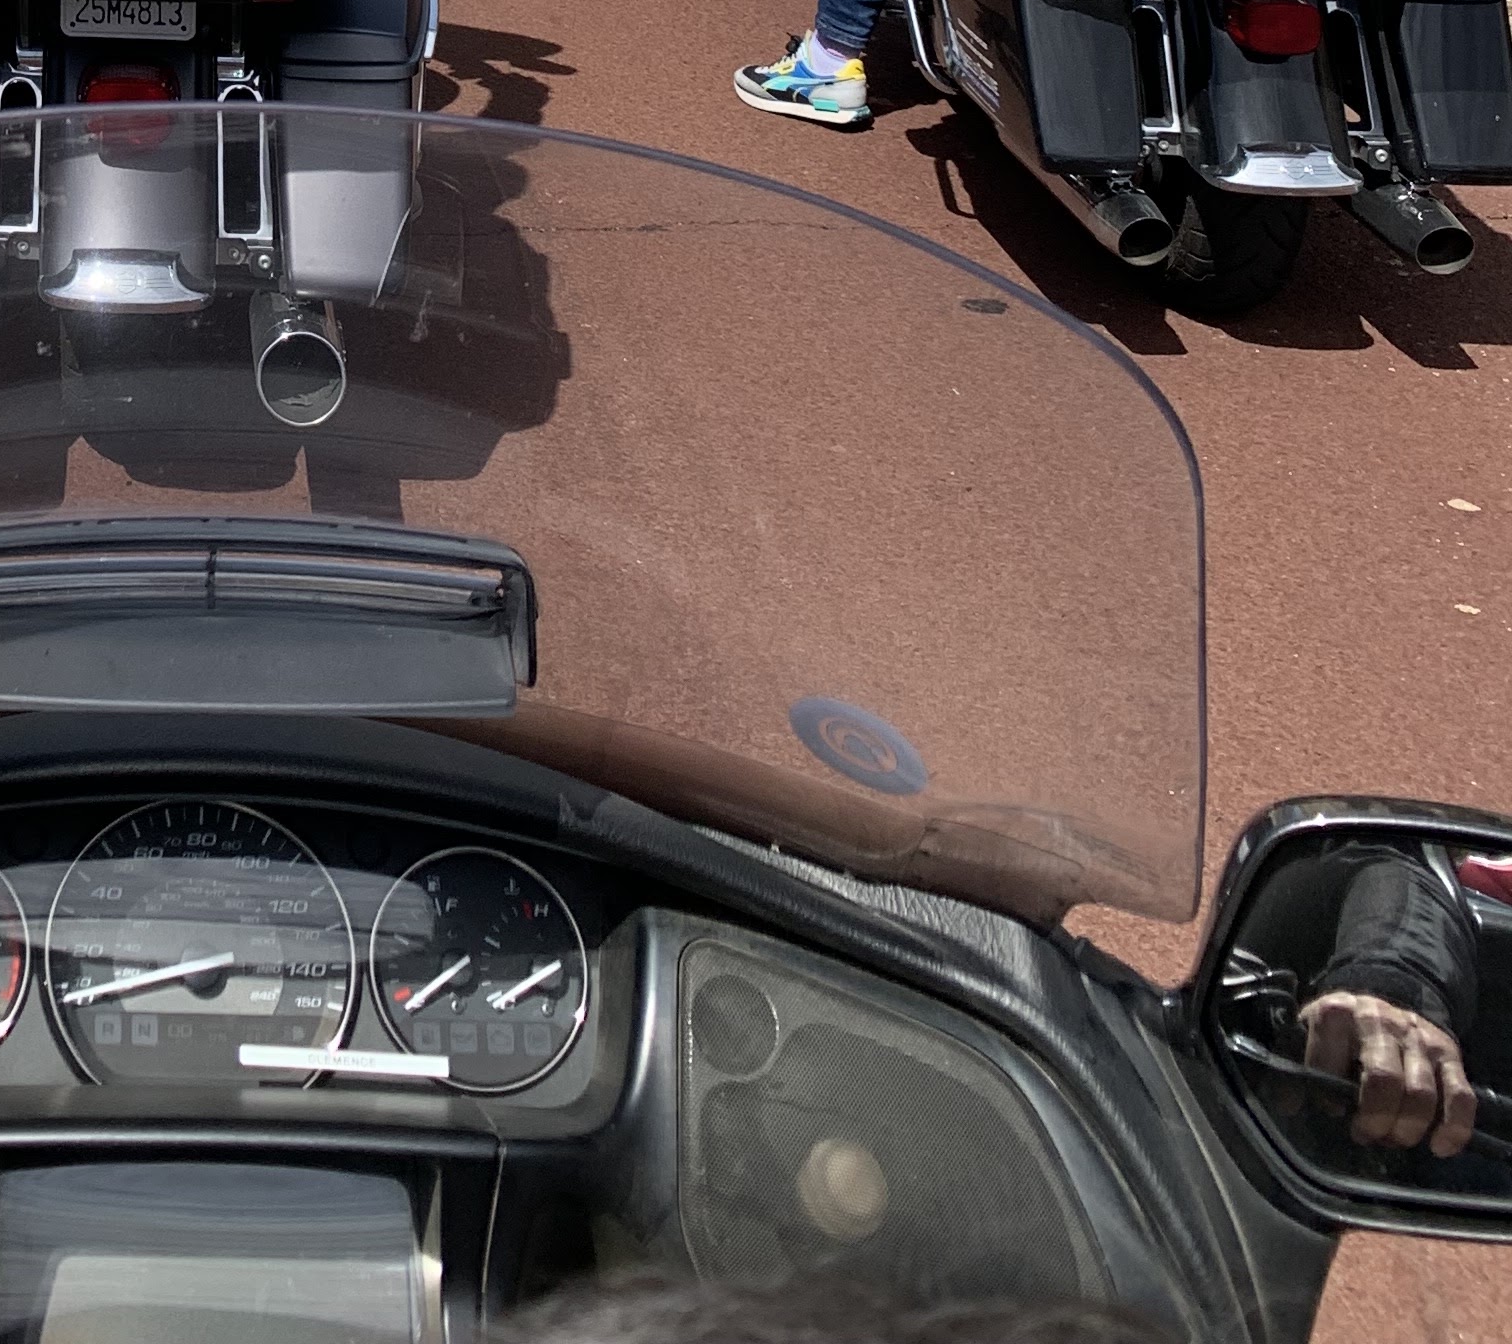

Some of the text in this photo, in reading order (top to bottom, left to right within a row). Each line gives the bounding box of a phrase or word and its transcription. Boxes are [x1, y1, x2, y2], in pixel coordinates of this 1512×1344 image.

[75, 0, 183, 25] 25M4813
[187, 834, 217, 846] 80
[90, 886, 123, 901] 40
[269, 900, 308, 913] 120
[445, 898, 459, 912] F
[534, 903, 549, 917] H
[289, 963, 327, 977] 140
[294, 996, 322, 1008] 150
